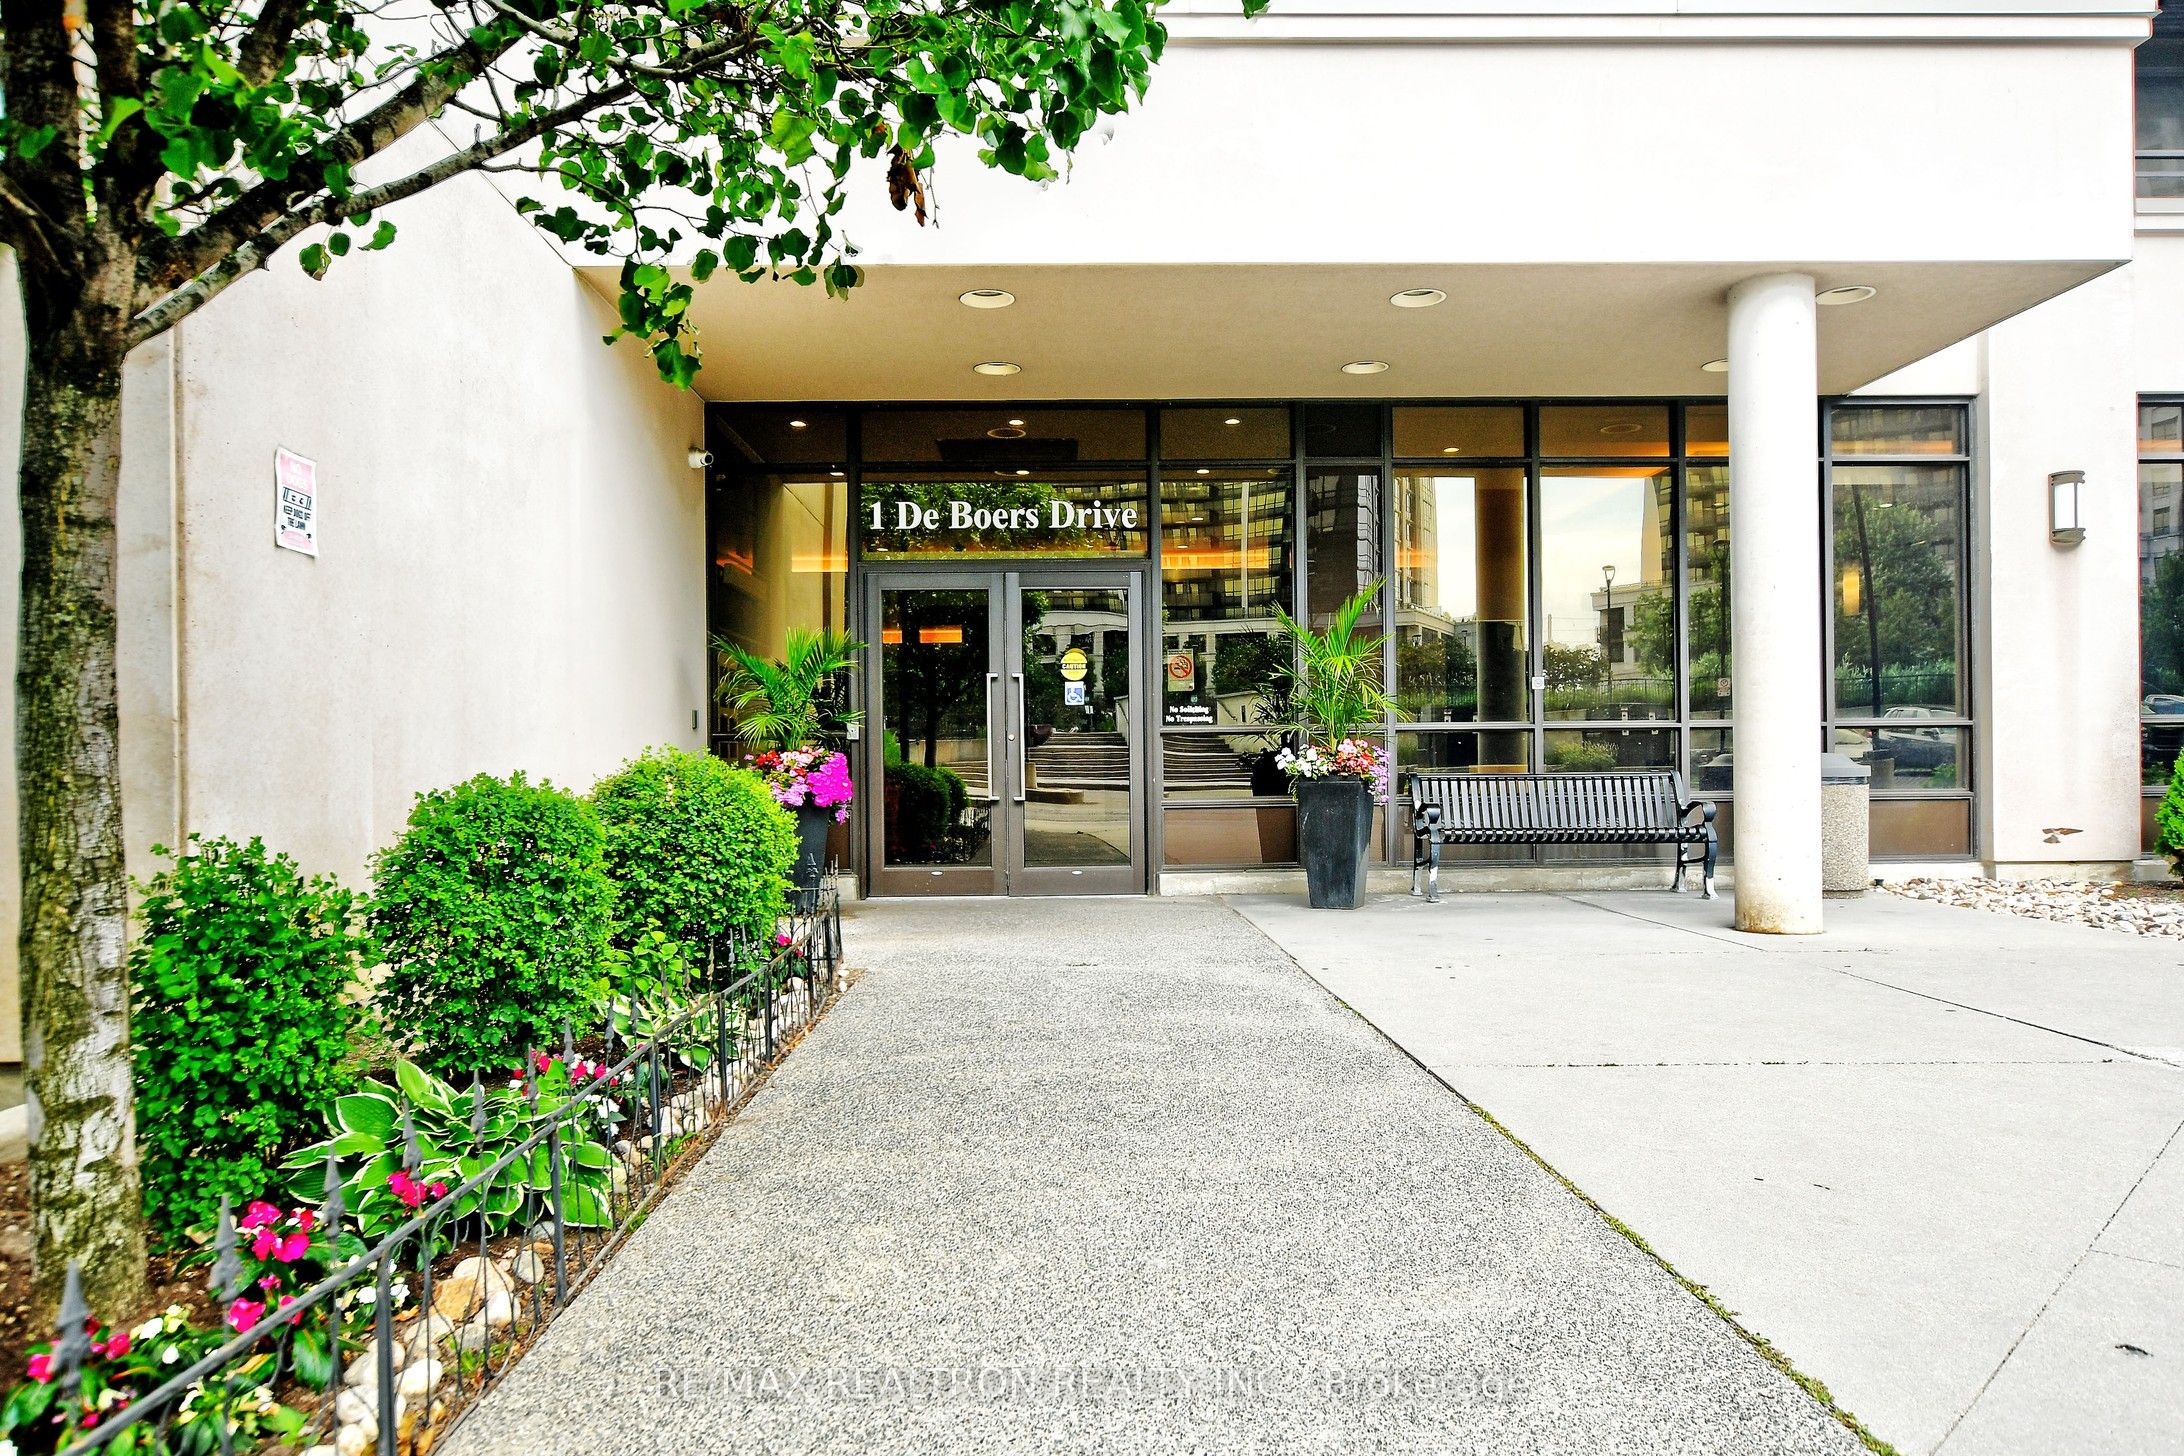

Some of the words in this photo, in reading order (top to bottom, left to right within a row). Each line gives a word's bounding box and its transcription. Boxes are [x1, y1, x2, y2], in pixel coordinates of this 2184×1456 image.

[869, 501, 885, 530] 1
[895, 501, 940, 530] De
[948, 501, 1040, 530] Boers
[1048, 500, 1138, 529] Drive
[1169, 705, 1179, 714] No
[1165, 714, 1175, 723] No
